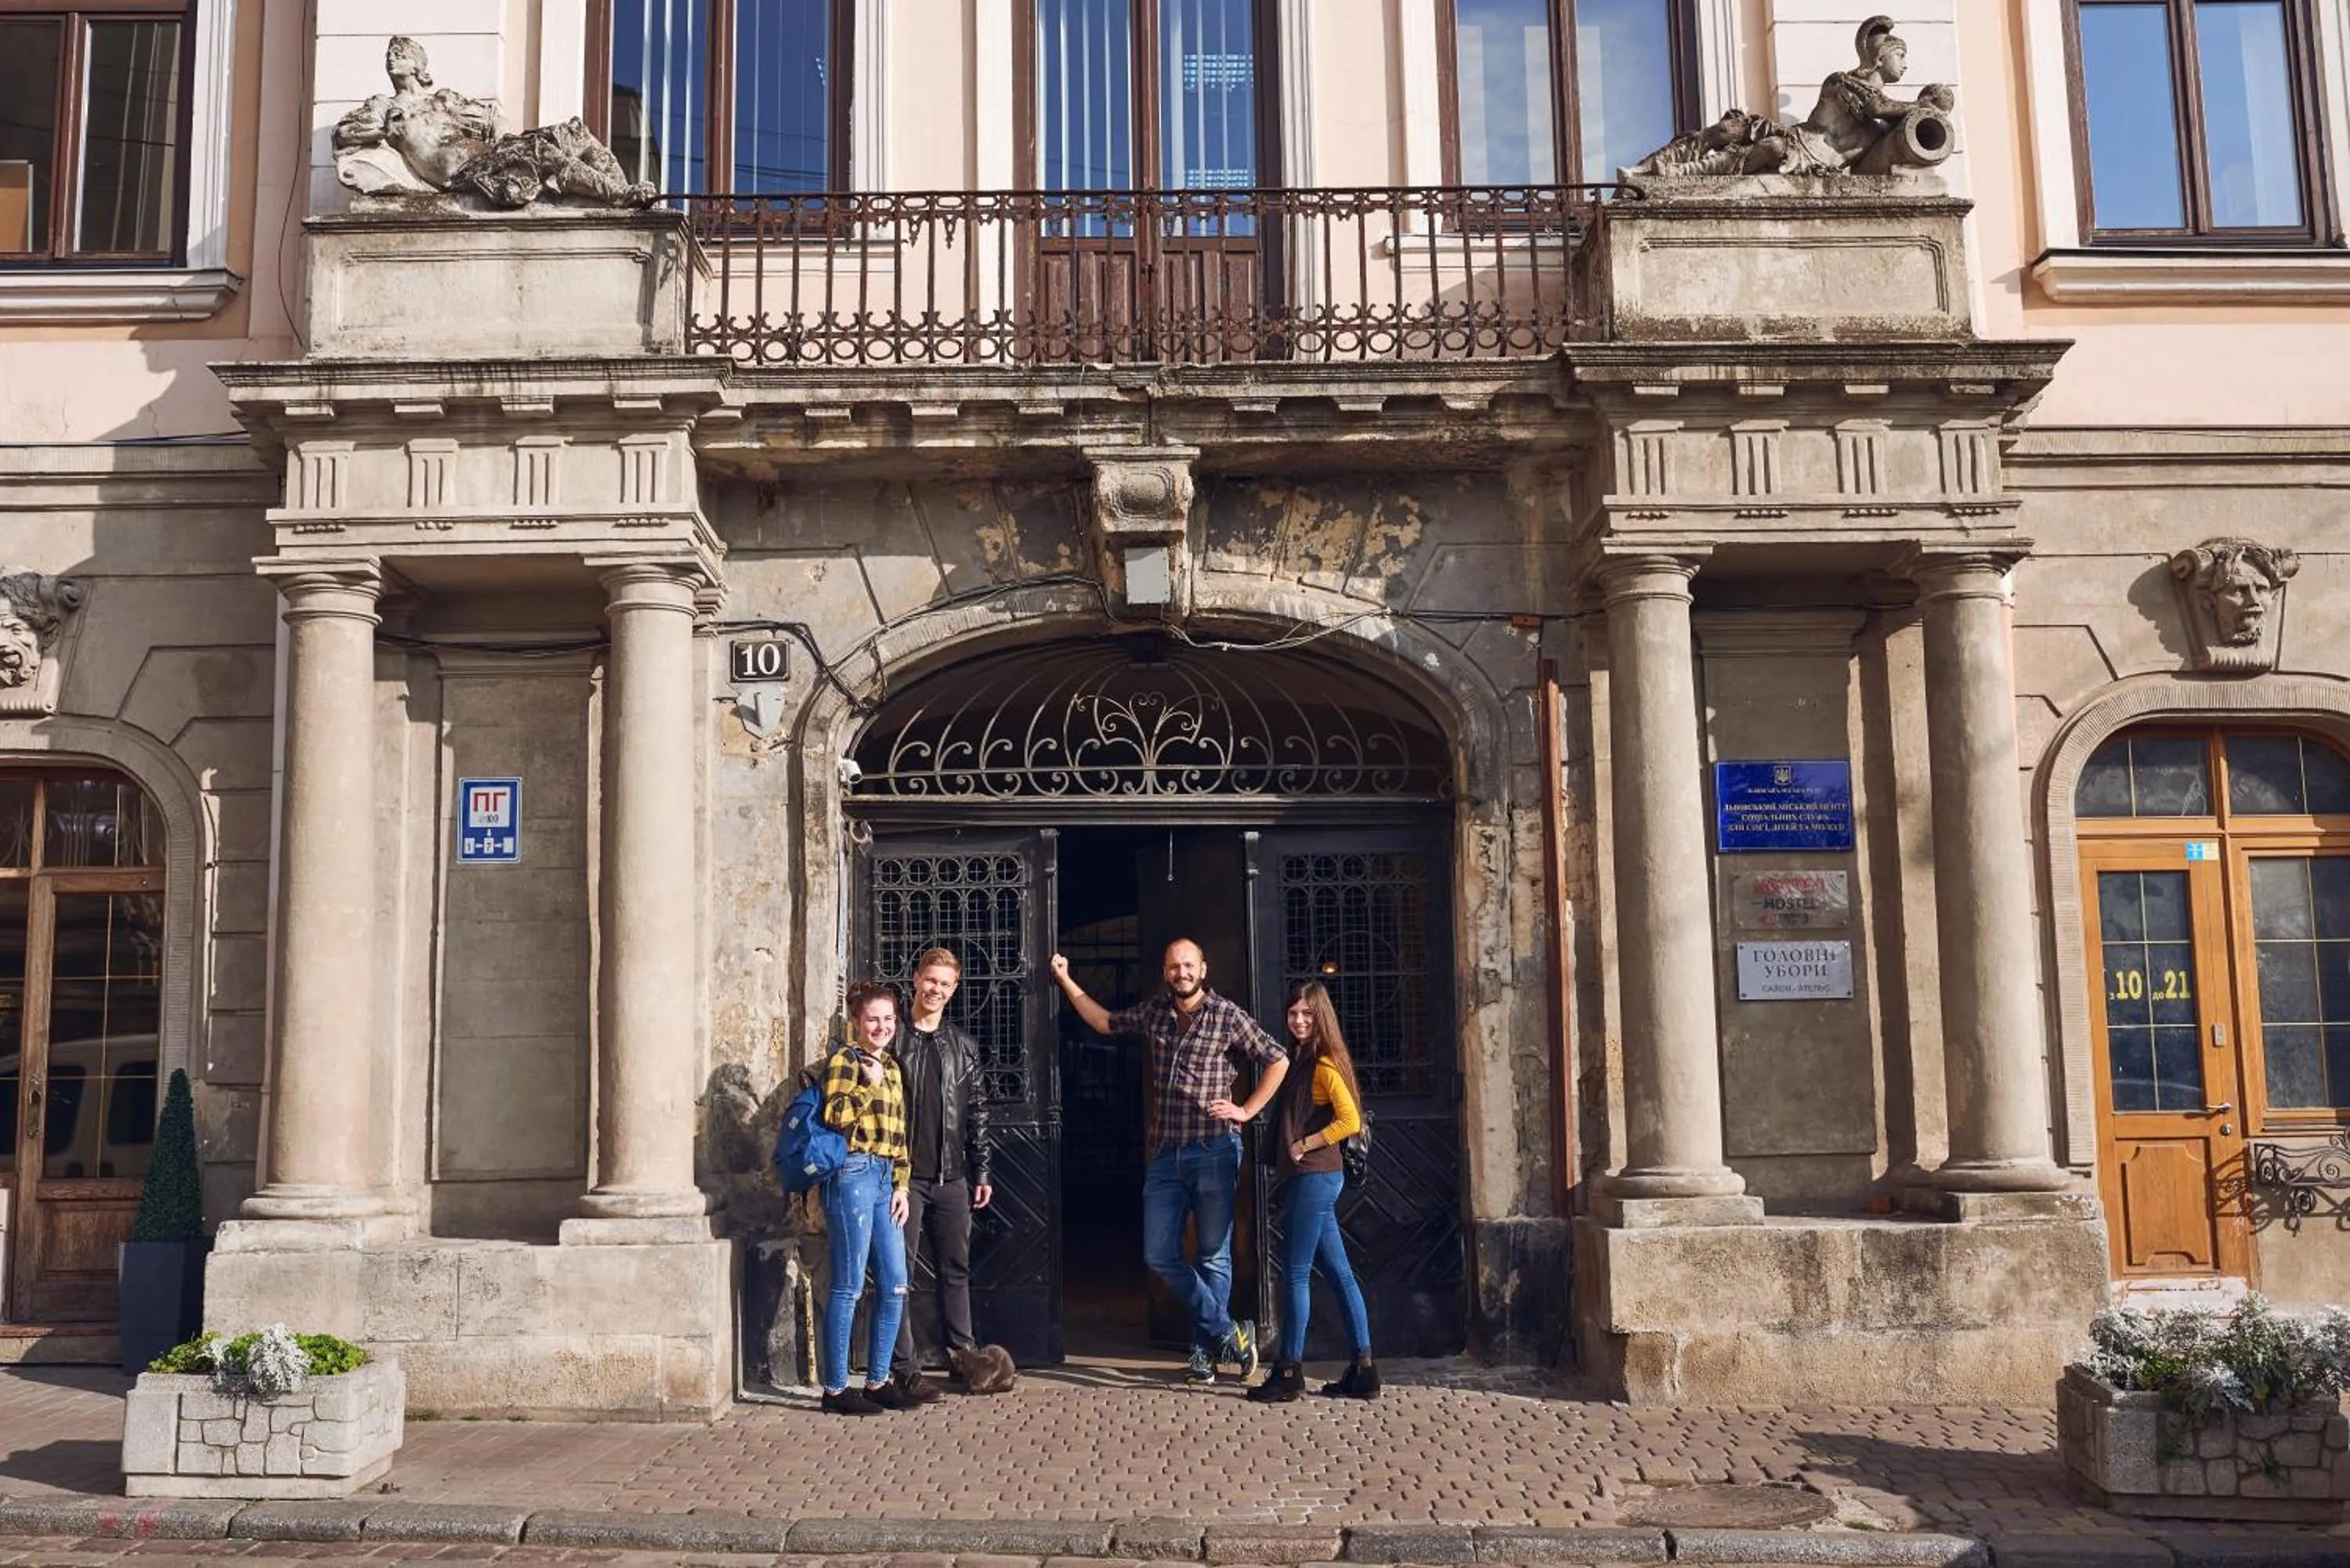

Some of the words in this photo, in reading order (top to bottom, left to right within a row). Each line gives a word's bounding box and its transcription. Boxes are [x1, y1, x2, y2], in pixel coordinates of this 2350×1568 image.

[741, 644, 781, 676] 10
[473, 792, 508, 812] ПГ
[1765, 964, 1828, 978] УБОРИ
[2116, 970, 2143, 1000] 10
[2164, 970, 2191, 1000] 21
